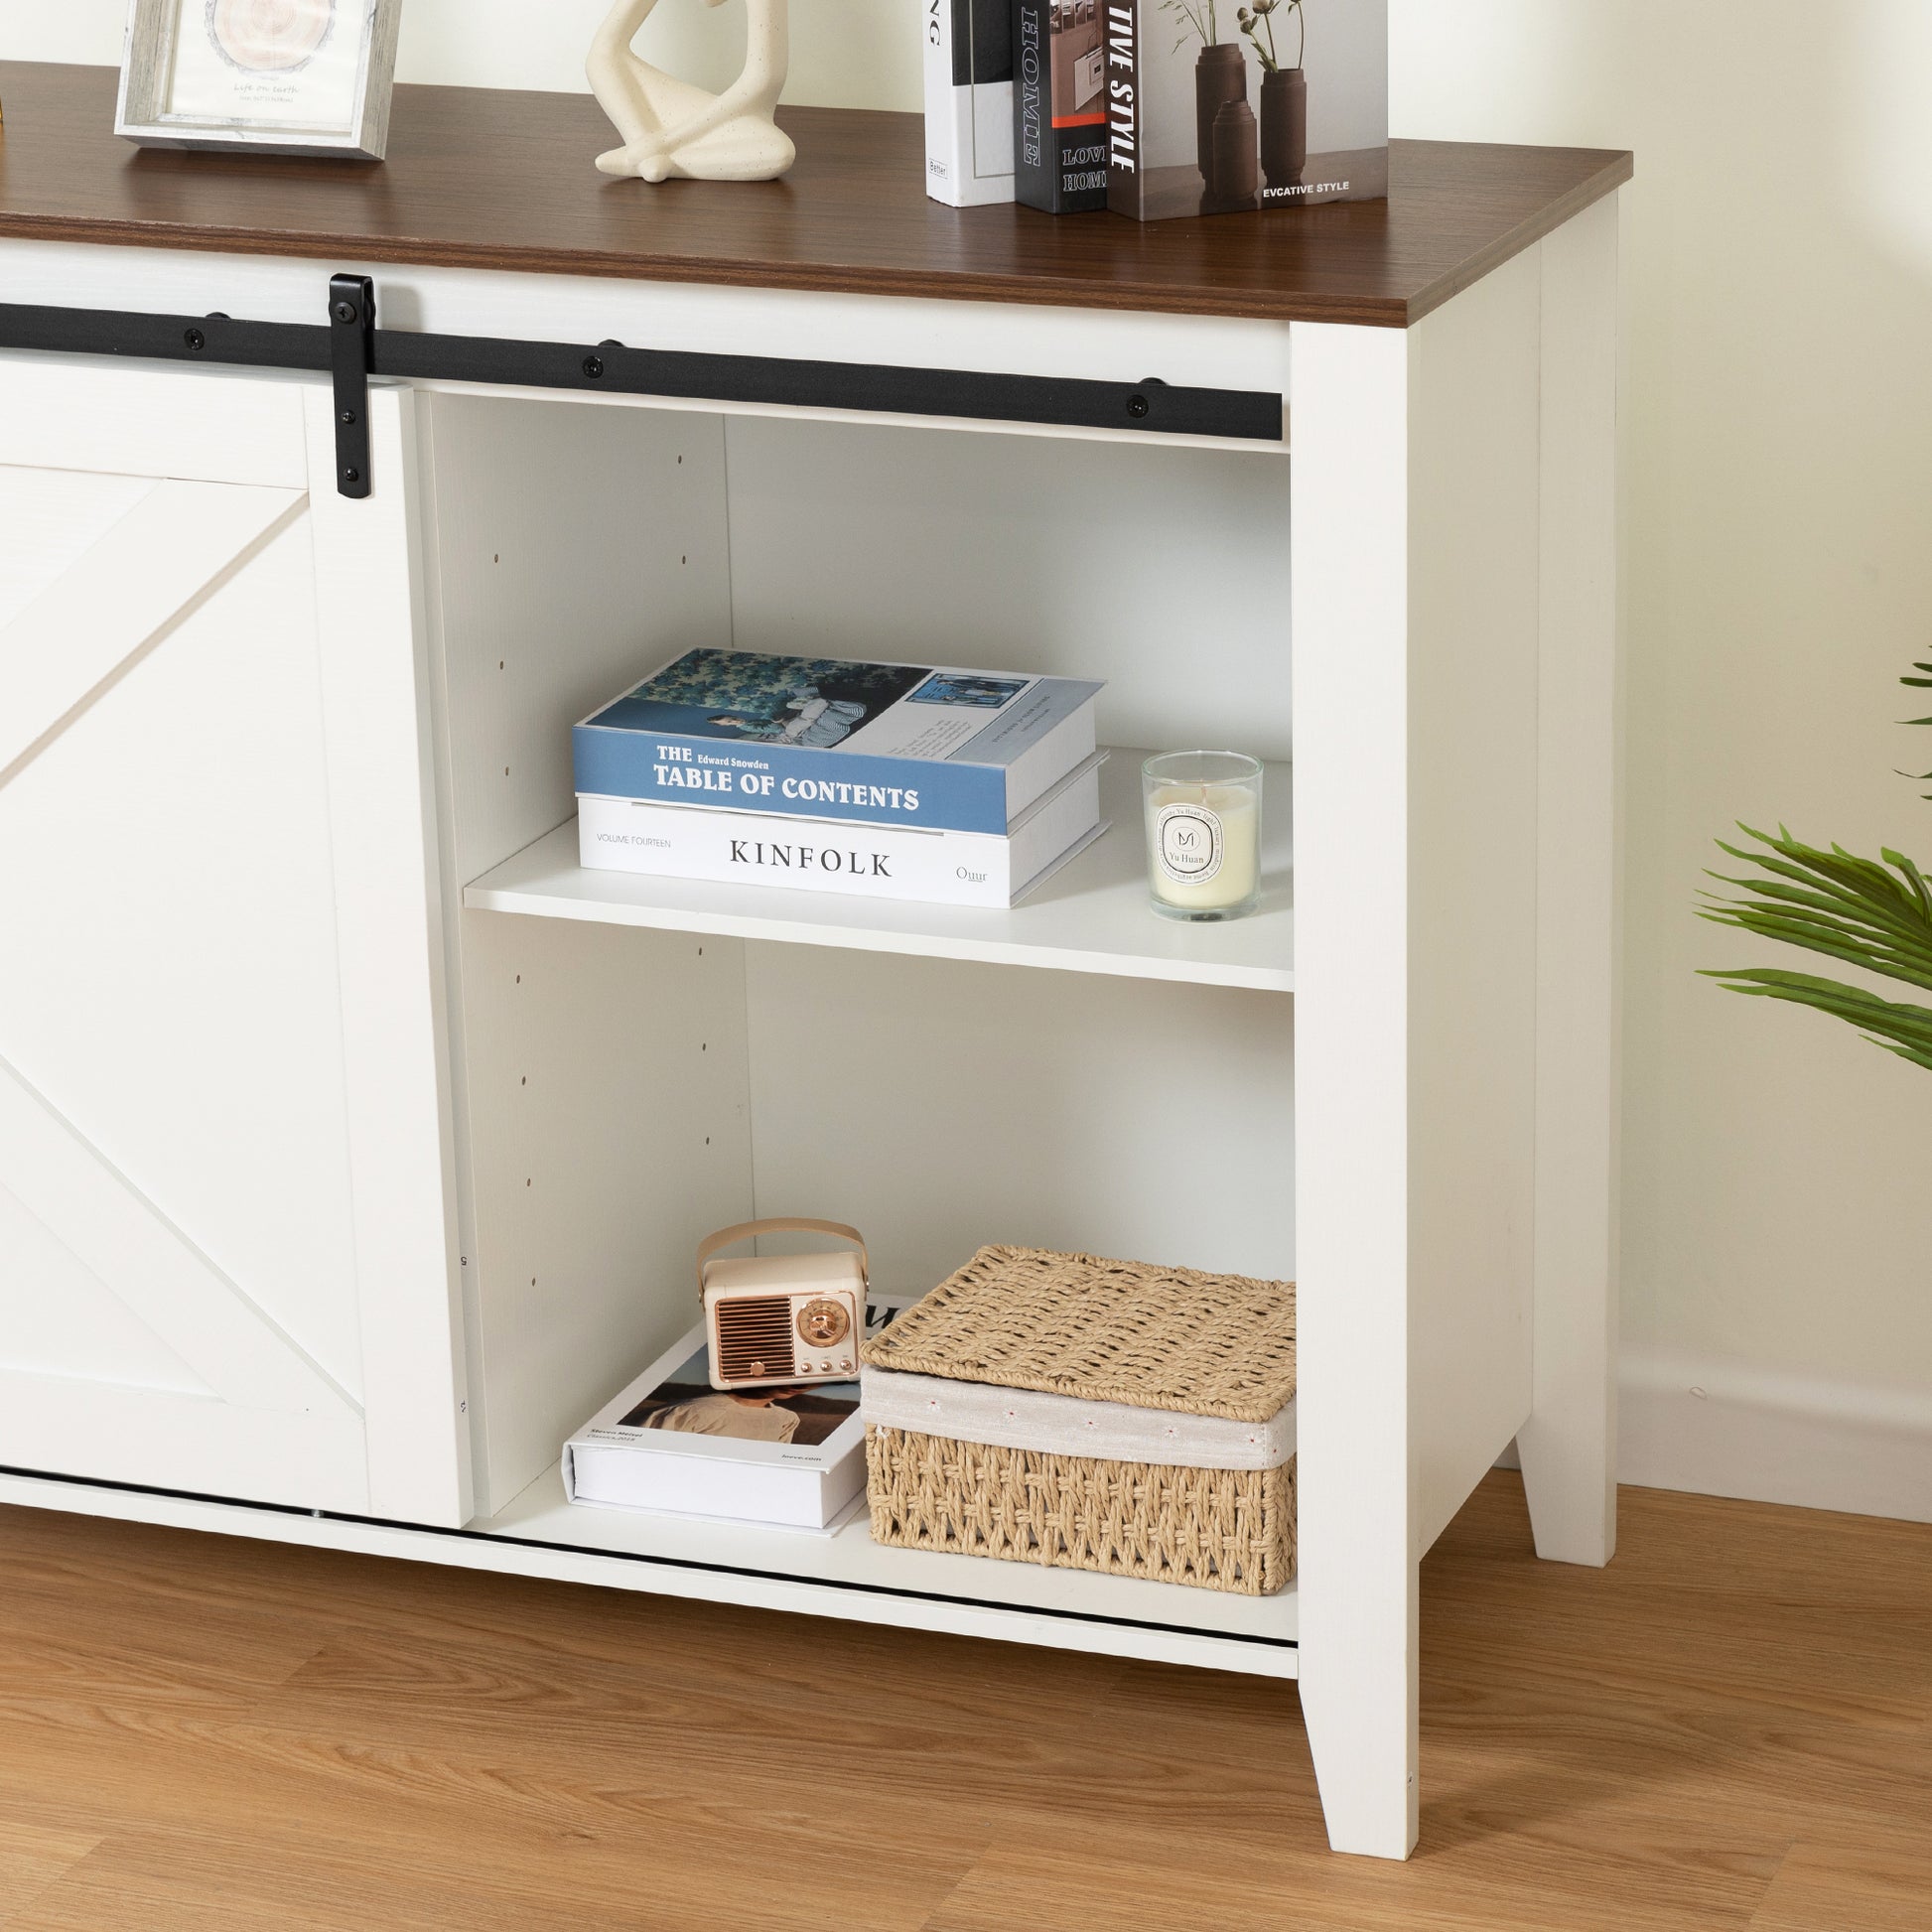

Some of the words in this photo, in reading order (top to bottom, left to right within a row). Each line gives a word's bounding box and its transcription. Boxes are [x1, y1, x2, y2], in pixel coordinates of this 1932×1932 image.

[1109, 7, 1133, 72] TIVE
[1021, 7, 1040, 167] HOME
[1110, 79, 1135, 174] STYLE
[1063, 170, 1108, 193] HOM
[1263, 184, 1313, 198] EVCATIVE
[1316, 181, 1349, 193] STYLE
[656, 745, 692, 762] THE
[697, 754, 730, 766] Edward
[731, 758, 769, 769] Snowden
[653, 763, 733, 792] TABLE
[740, 773, 774, 795] OF
[781, 777, 919, 811] CONTENTS
[596, 833, 629, 844] VOLUME
[630, 835, 671, 848] FOURTEEN
[730, 839, 893, 878] KINFOLK
[1170, 851, 1179, 862] Yu
[1181, 853, 1204, 864] Huan
